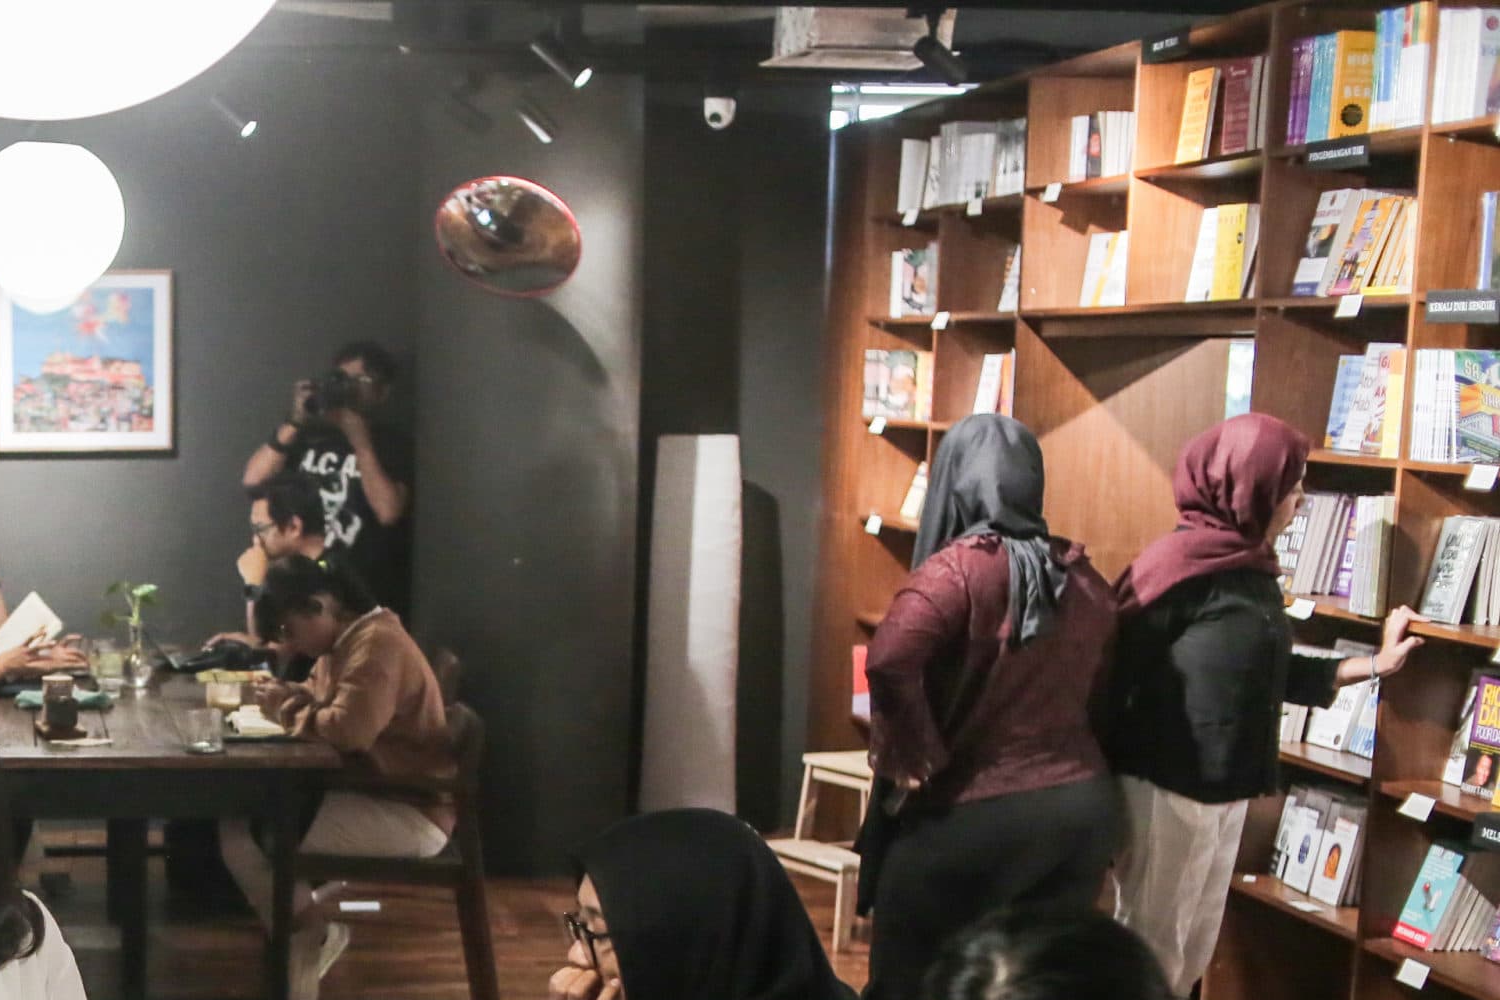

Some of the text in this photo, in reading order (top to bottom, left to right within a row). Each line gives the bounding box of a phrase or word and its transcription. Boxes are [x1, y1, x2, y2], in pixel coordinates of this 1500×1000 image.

[1428, 300, 1497, 313] KENALI DIRI SENDIRI
